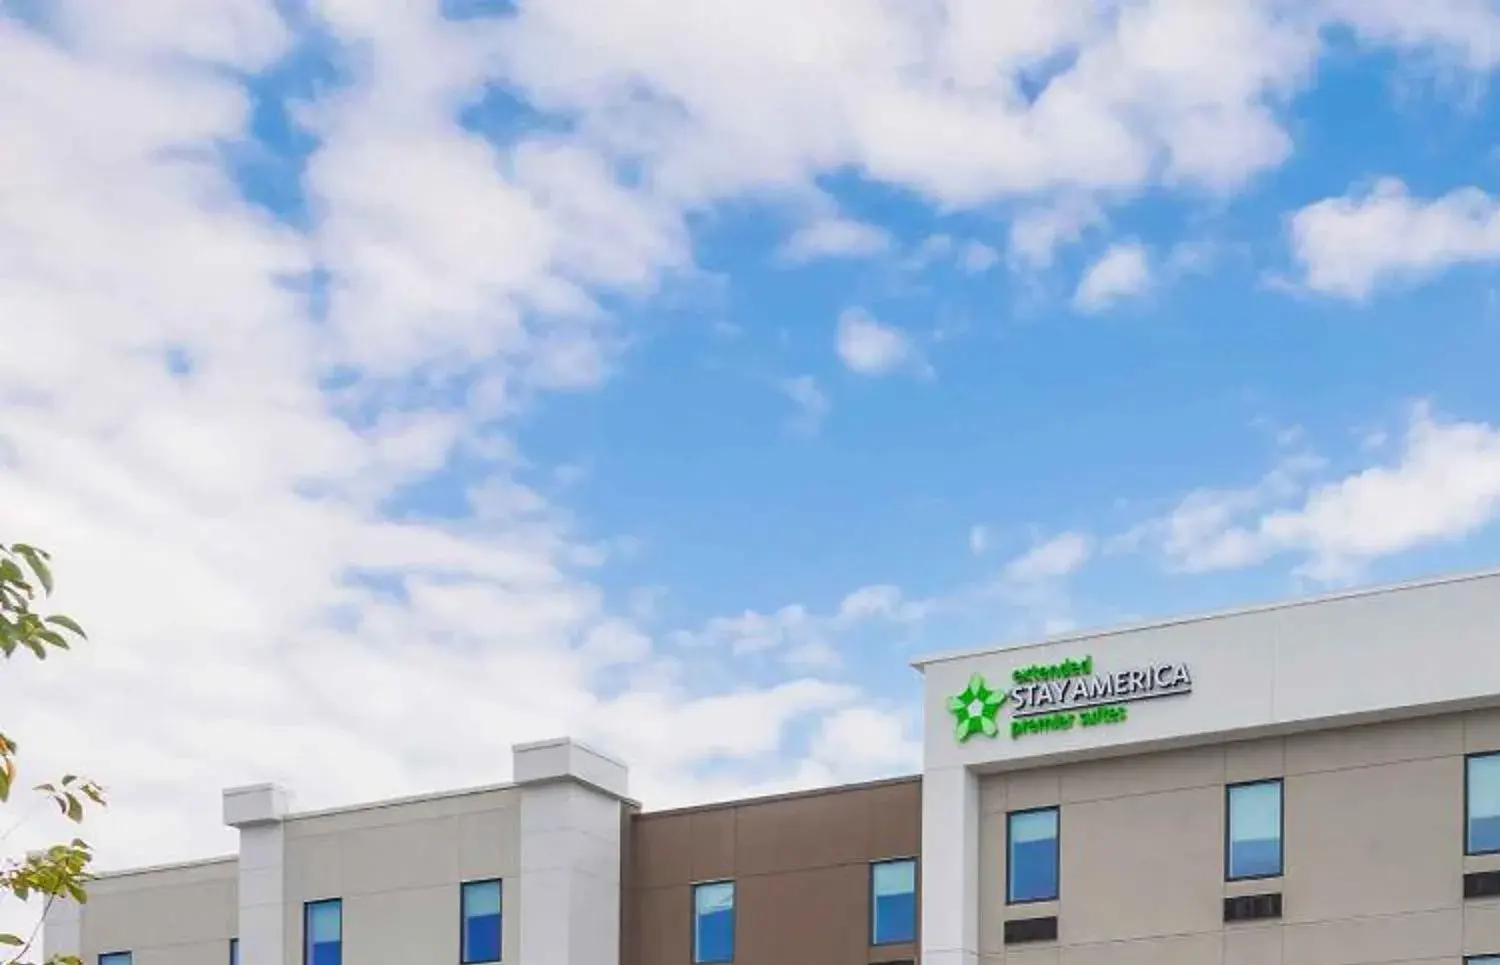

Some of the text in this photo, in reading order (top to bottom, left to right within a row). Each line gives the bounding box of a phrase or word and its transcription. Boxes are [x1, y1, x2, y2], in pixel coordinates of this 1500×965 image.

[1010, 662, 1192, 710] STAY AMERICA
[1012, 655, 1092, 684] extended
[1011, 706, 1127, 740] premier suites
